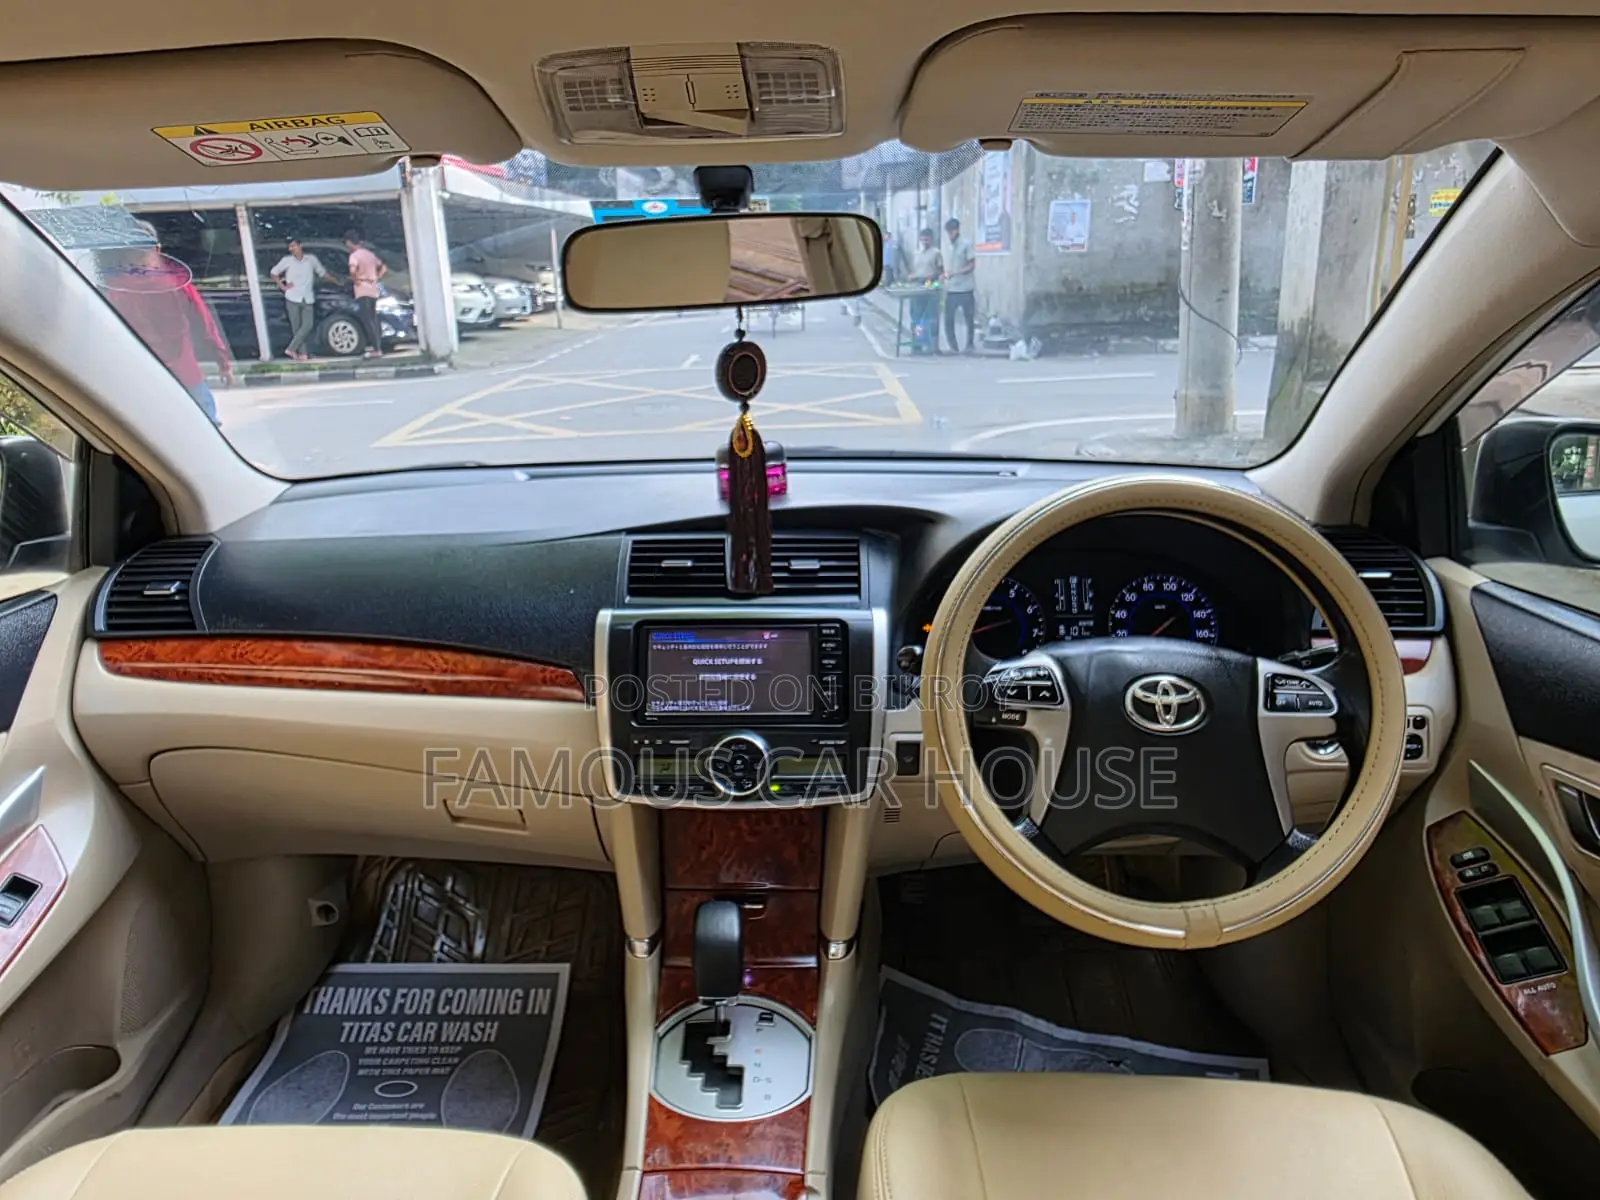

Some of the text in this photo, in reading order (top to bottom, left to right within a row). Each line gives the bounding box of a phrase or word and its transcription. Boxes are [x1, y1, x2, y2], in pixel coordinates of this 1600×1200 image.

[249, 116, 346, 131] AIRBAG
[1143, 583, 1154, 591] 80
[1163, 582, 1177, 591] 100
[1009, 589, 1015, 598] 5
[1125, 593, 1136, 602] 60
[1181, 593, 1194, 602] 120
[1026, 605, 1033, 614] 6
[1115, 610, 1127, 619] 40
[1193, 610, 1207, 619] 140
[1032, 627, 1039, 637] 7
[1116, 629, 1127, 638] 20
[1195, 629, 1209, 638] 160
[304, 987, 552, 1015] THANKS FOR COMING IN
[339, 1022, 499, 1043] TITAS CAR WASH
